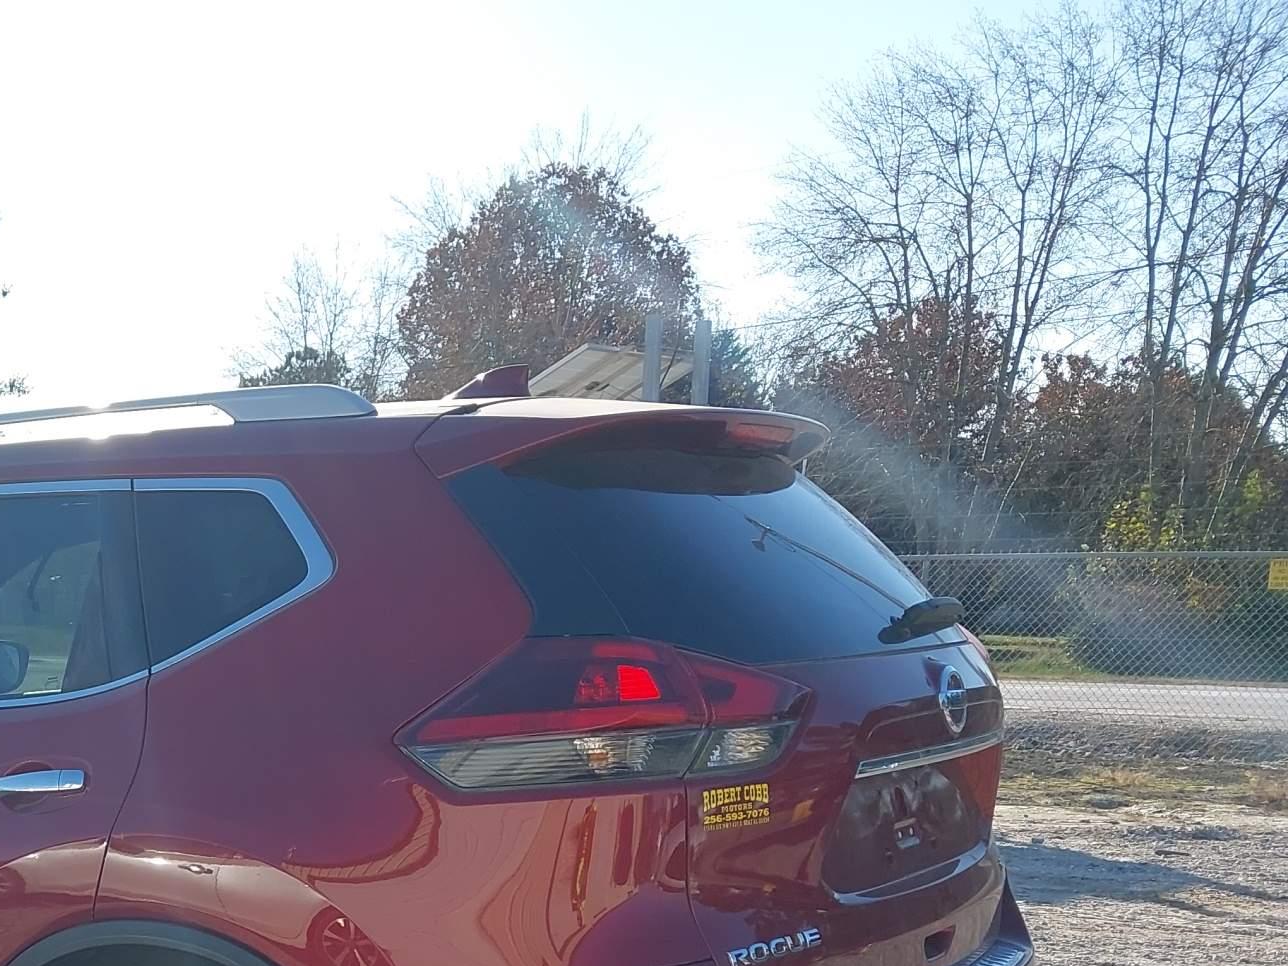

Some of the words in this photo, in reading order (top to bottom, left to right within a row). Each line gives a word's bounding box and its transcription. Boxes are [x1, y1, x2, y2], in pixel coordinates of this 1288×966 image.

[702, 786, 742, 813] ROBERT
[743, 783, 770, 804] COBB
[703, 807, 770, 825] 256-593-7076
[721, 802, 753, 813] MOTORS
